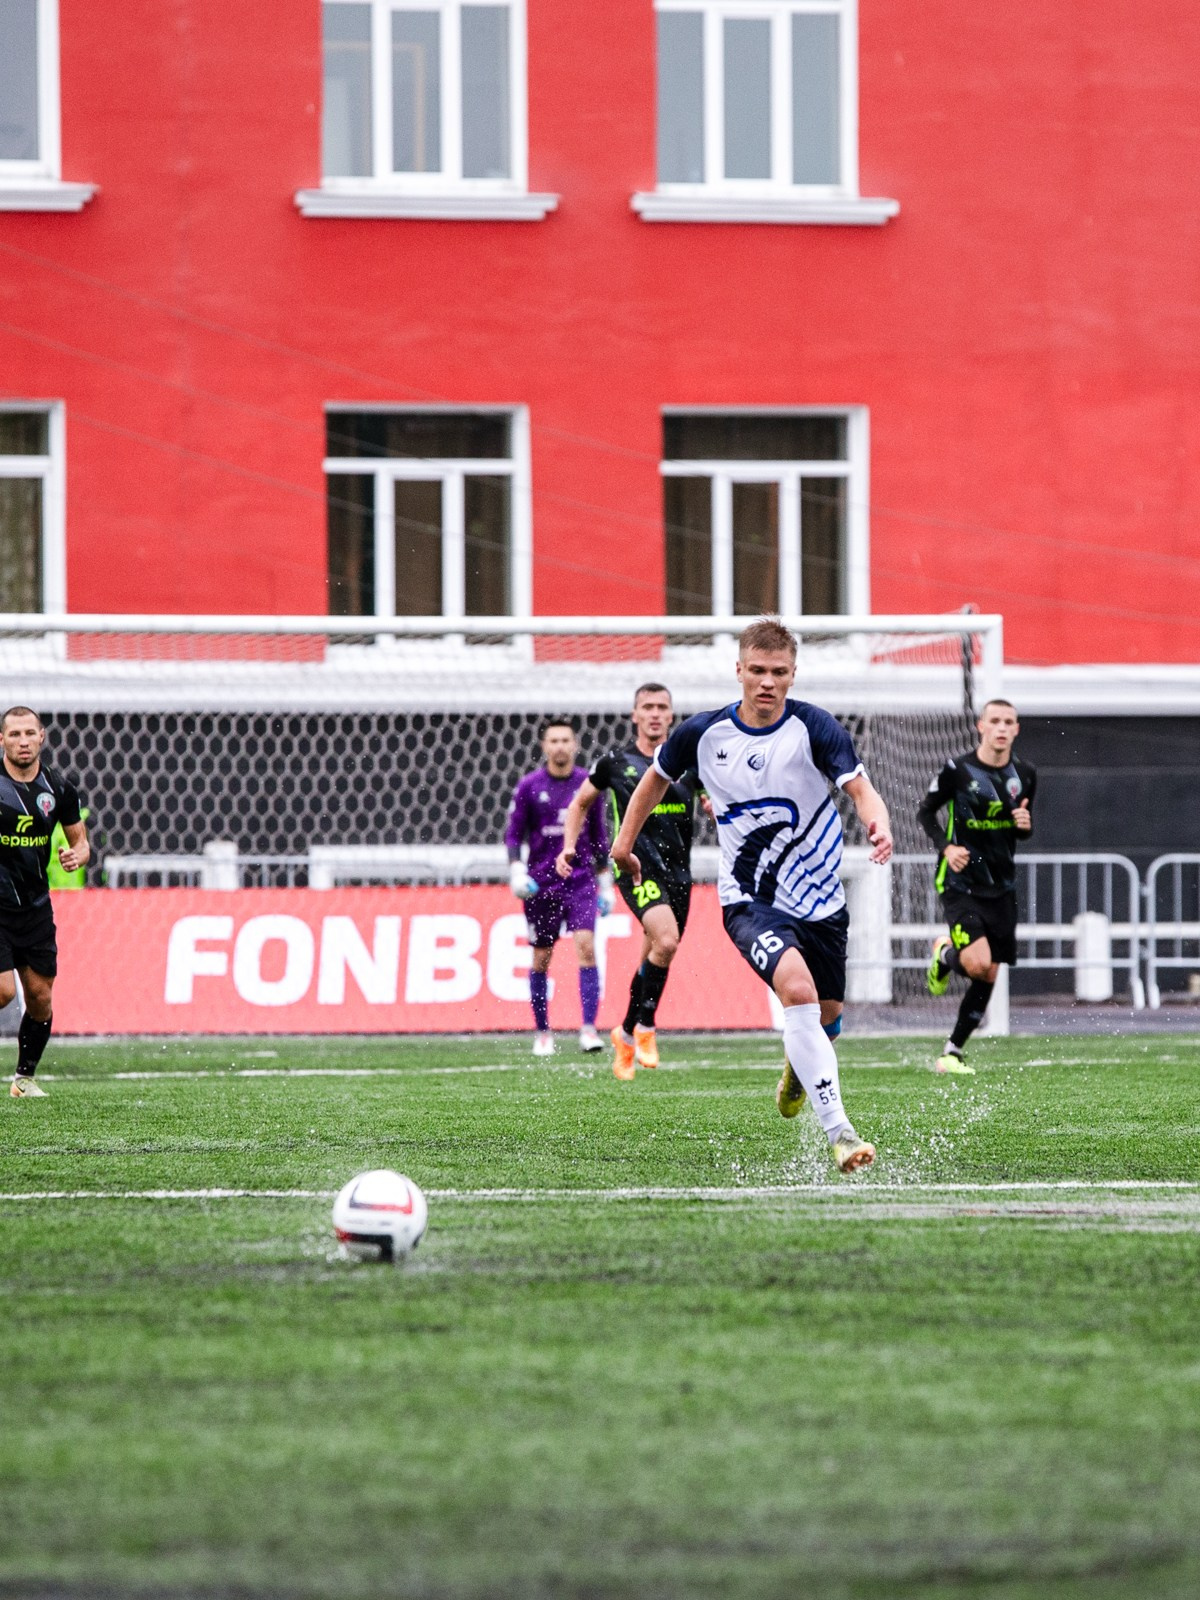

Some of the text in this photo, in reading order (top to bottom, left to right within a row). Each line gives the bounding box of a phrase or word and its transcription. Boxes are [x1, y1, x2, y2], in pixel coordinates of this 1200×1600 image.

[0, 834, 49, 848] ервико
[632, 879, 662, 909] 28
[163, 913, 632, 1006] FONBET
[750, 929, 785, 971] 55
[818, 1087, 838, 1106] 55
